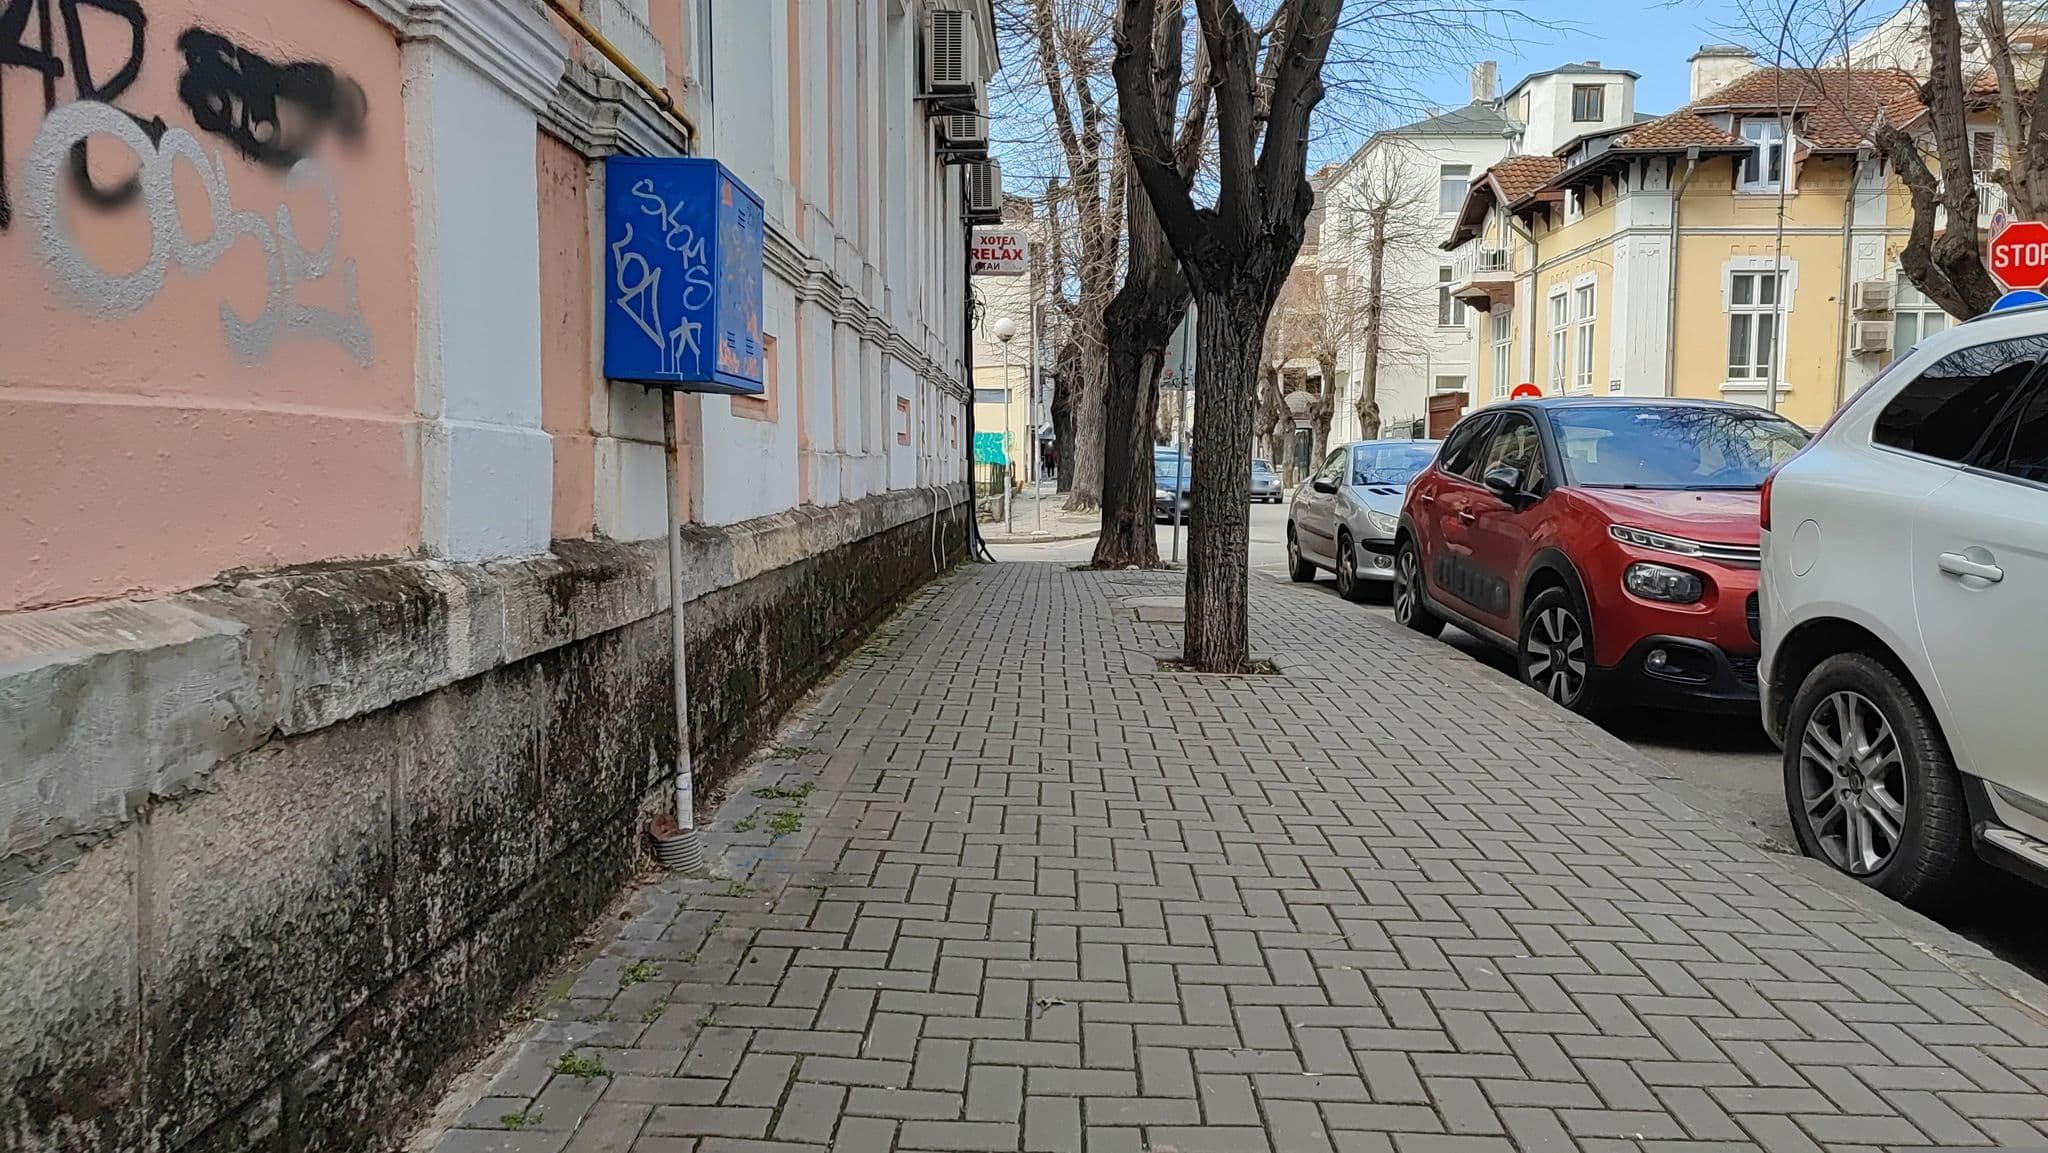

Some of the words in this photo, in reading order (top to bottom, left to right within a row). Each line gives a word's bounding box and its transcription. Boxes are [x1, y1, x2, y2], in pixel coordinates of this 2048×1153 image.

[980, 235, 1016, 246] ХОТЕЛ
[971, 247, 1023, 261] RELAX
[1994, 242, 2048, 268] STOP
